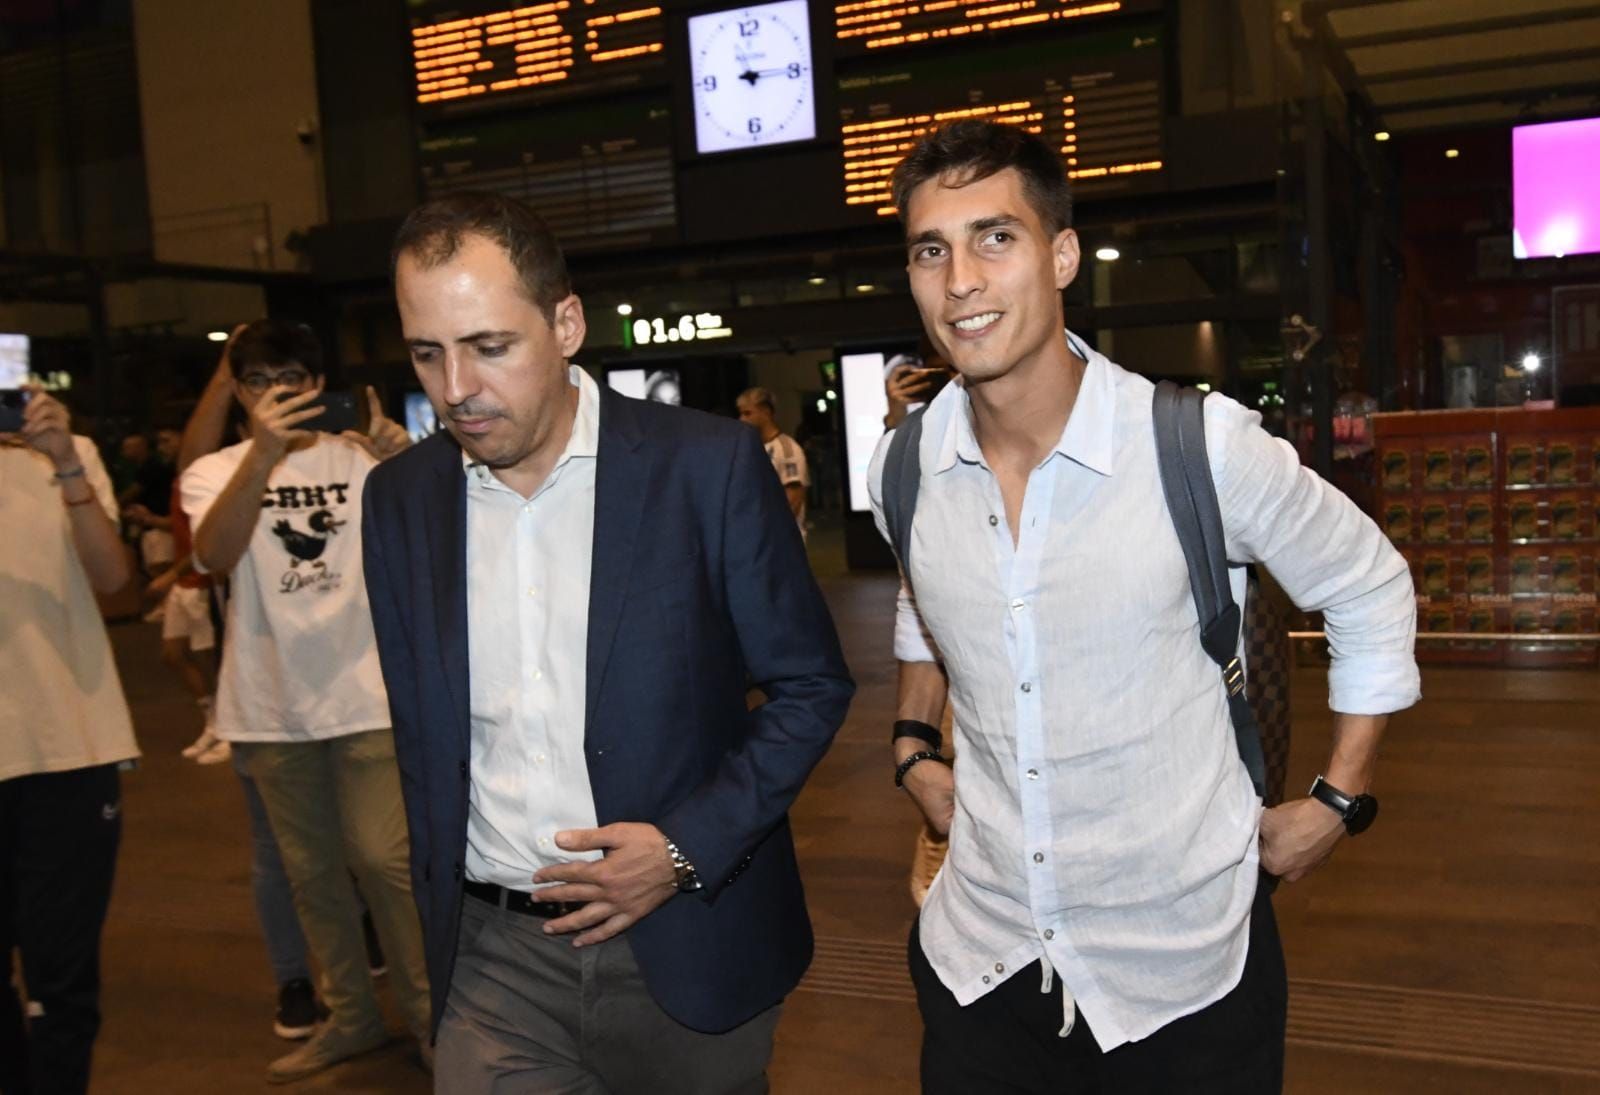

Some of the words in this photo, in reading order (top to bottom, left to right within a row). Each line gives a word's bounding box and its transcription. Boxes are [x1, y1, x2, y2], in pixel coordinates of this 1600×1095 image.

[739, 19, 759, 37] 12
[787, 62, 800, 79] 3
[703, 75, 717, 91] 9
[748, 117, 762, 134] 6
